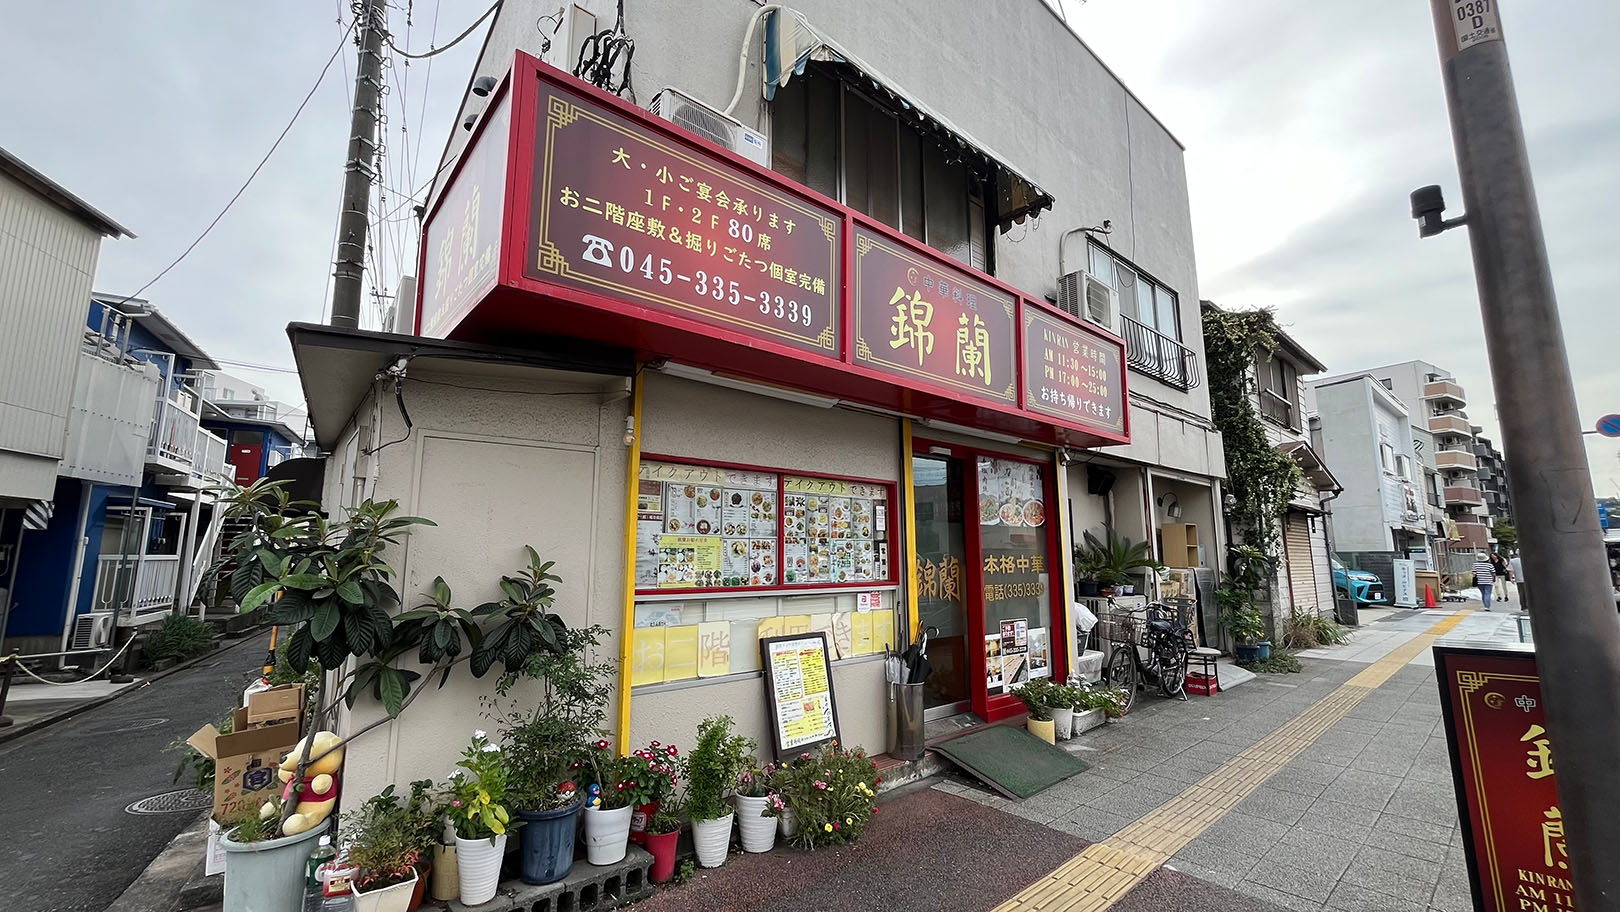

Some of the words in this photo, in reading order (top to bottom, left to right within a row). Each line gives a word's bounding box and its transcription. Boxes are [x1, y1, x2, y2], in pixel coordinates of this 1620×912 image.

[1472, 15, 1484, 29] D
[611, 147, 797, 235] 大・小ご宴会承ります
[619, 245, 812, 327] 045-335-3339
[922, 275, 978, 311] 中華料理
[889, 286, 992, 386] 錦蘭
[1043, 327, 1069, 349] KINRAN
[1072, 340, 1106, 366] 営業時間
[1043, 347, 1054, 362] AM
[1044, 364, 1055, 380] PM
[1040, 385, 1112, 419] お持ち帰りできます
[639, 463, 777, 488] テイクアウトできます
[784, 479, 885, 497] テイクアウトできます
[983, 554, 1045, 575] 本格中華
[1514, 884, 1546, 902] AM
